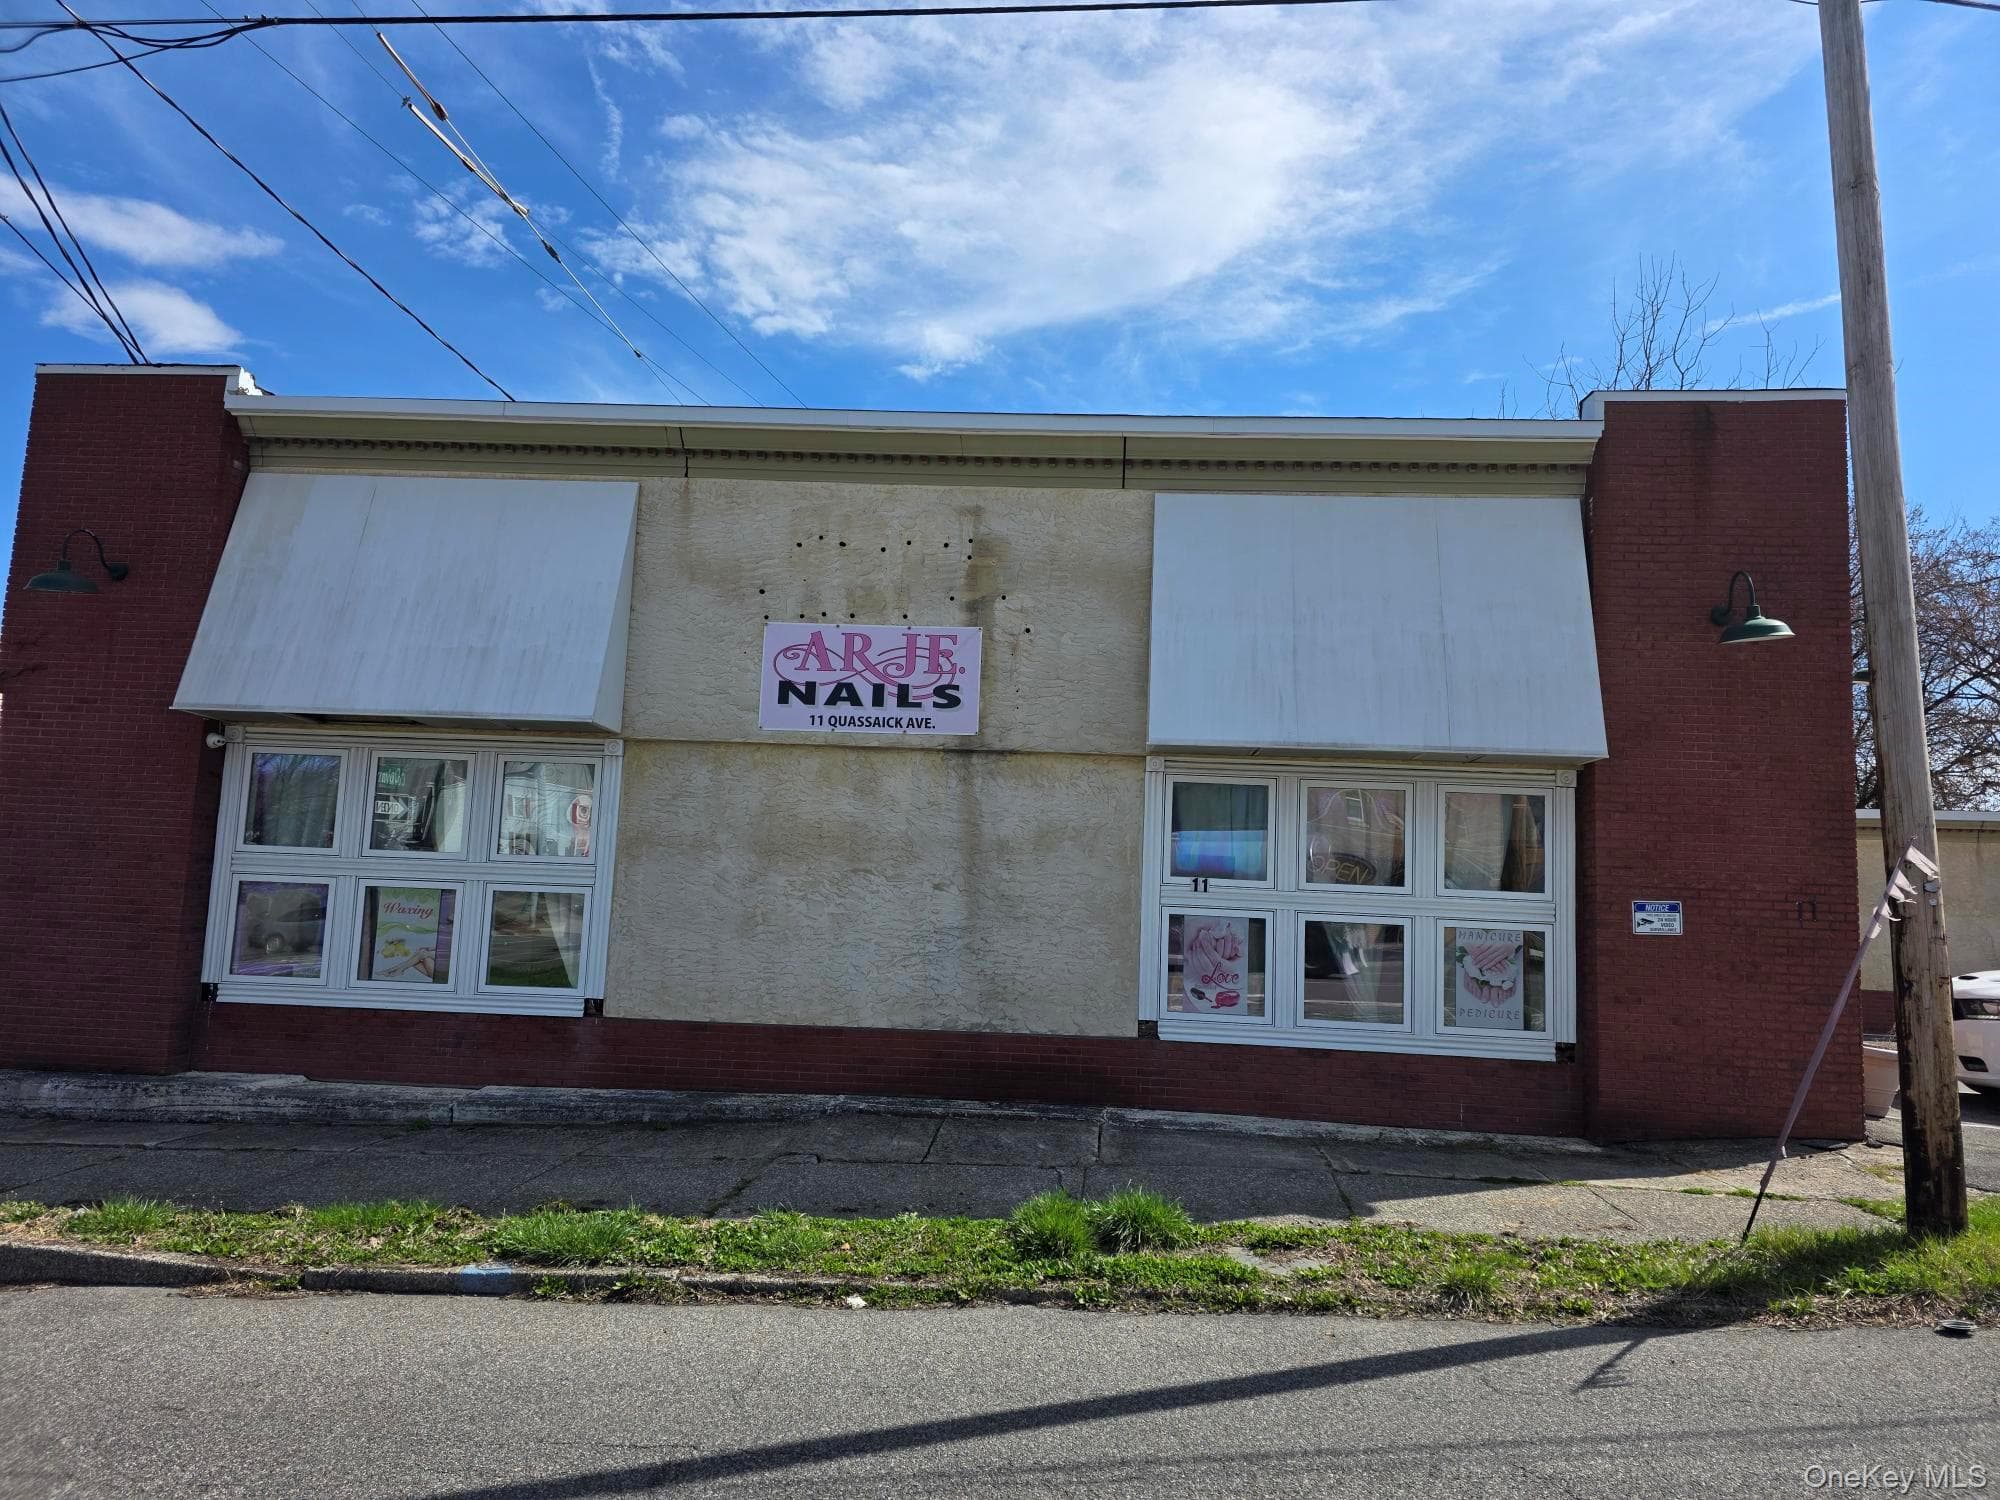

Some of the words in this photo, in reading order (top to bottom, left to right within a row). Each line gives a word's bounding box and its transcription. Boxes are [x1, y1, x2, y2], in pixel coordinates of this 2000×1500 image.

[777, 680, 963, 709] NAILS
[809, 715, 824, 727] 11
[828, 715, 903, 729] QUASSAICK
[906, 717, 936, 729] AVE.
[1311, 855, 1370, 884] OPEN
[1191, 876, 1209, 893] 11
[384, 900, 434, 919] Waxing
[1645, 903, 1670, 912] NOTICE
[1458, 930, 1521, 943] MANICURE
[1201, 961, 1242, 989] Love
[1459, 1008, 1521, 1021] PEDICURE
